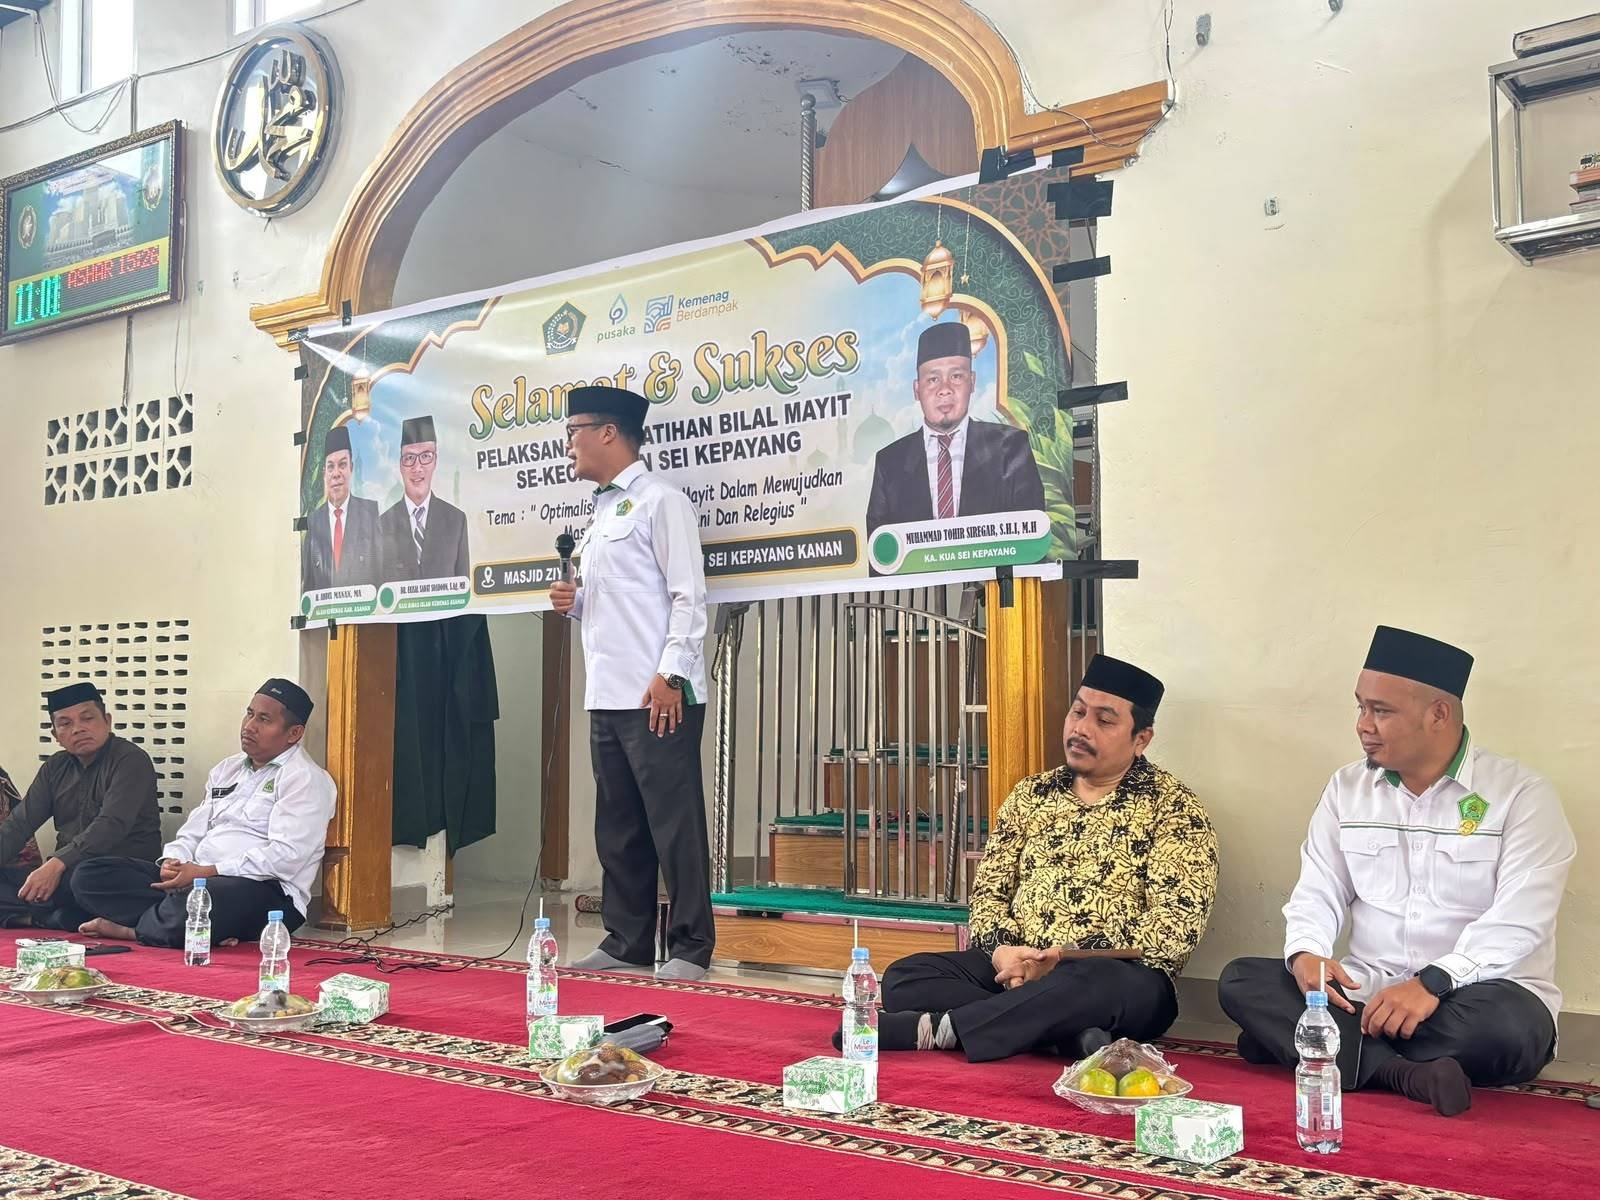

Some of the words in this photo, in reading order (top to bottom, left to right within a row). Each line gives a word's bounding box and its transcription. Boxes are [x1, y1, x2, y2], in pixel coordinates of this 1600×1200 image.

[676, 300, 738, 322] Berdampak
[678, 291, 729, 309] Kemenag
[596, 325, 636, 343] pusaka
[643, 351, 682, 404] &
[692, 330, 859, 404] Sukses
[477, 439, 569, 470] PELAKSAN
[719, 406, 779, 434] BILAL
[784, 393, 851, 424] MAYIT
[516, 463, 584, 489] SE-KEC
[658, 447, 689, 471] SEI
[695, 431, 802, 466] KEPAYANG
[486, 510, 516, 526] Tema
[720, 479, 758, 501] Dalam
[763, 468, 843, 496] Mewujudkan
[716, 508, 739, 526] Dan
[744, 501, 795, 526] Relegius
[905, 530, 942, 545] MUHAMMAD
[943, 527, 965, 542] TOHIR
[966, 524, 998, 539] SIREGAR,
[504, 569, 543, 585] MASJID
[708, 552, 728, 568] SEI
[731, 545, 795, 566] KEPAYANG
[798, 540, 843, 559] KANAN
[924, 554, 938, 563] KA.
[939, 552, 956, 561] KUA
[957, 550, 971, 560] SEI
[973, 547, 1017, 559] KEPAYANG
